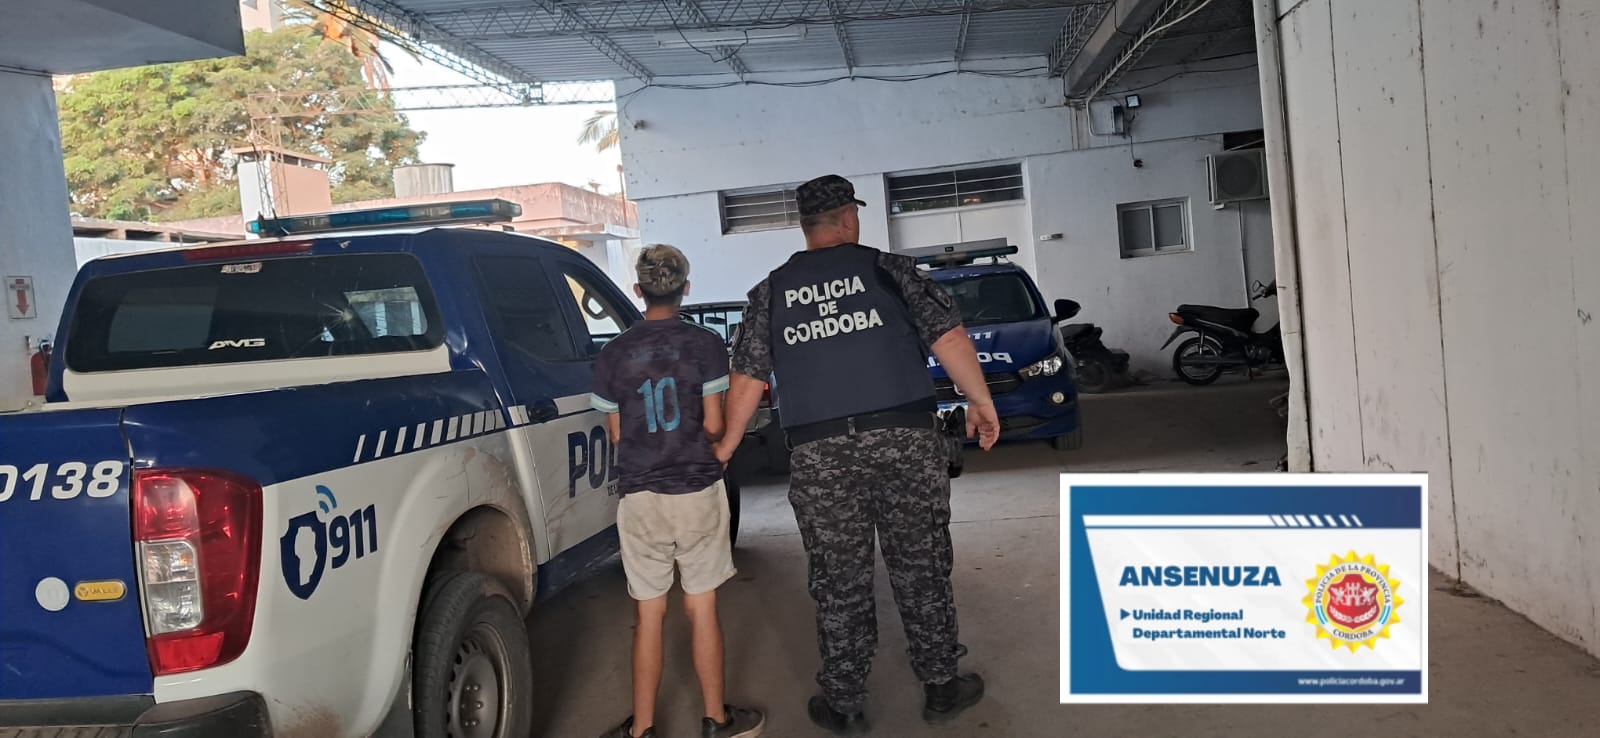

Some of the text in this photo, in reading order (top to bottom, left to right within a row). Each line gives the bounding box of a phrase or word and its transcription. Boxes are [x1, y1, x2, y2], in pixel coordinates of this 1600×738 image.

[785, 275, 866, 308] POLICIA
[818, 301, 838, 317] DE
[208, 338, 266, 350] AMG
[783, 308, 884, 345] CORDOBA
[637, 376, 681, 433] 10
[328, 503, 378, 569] 911
